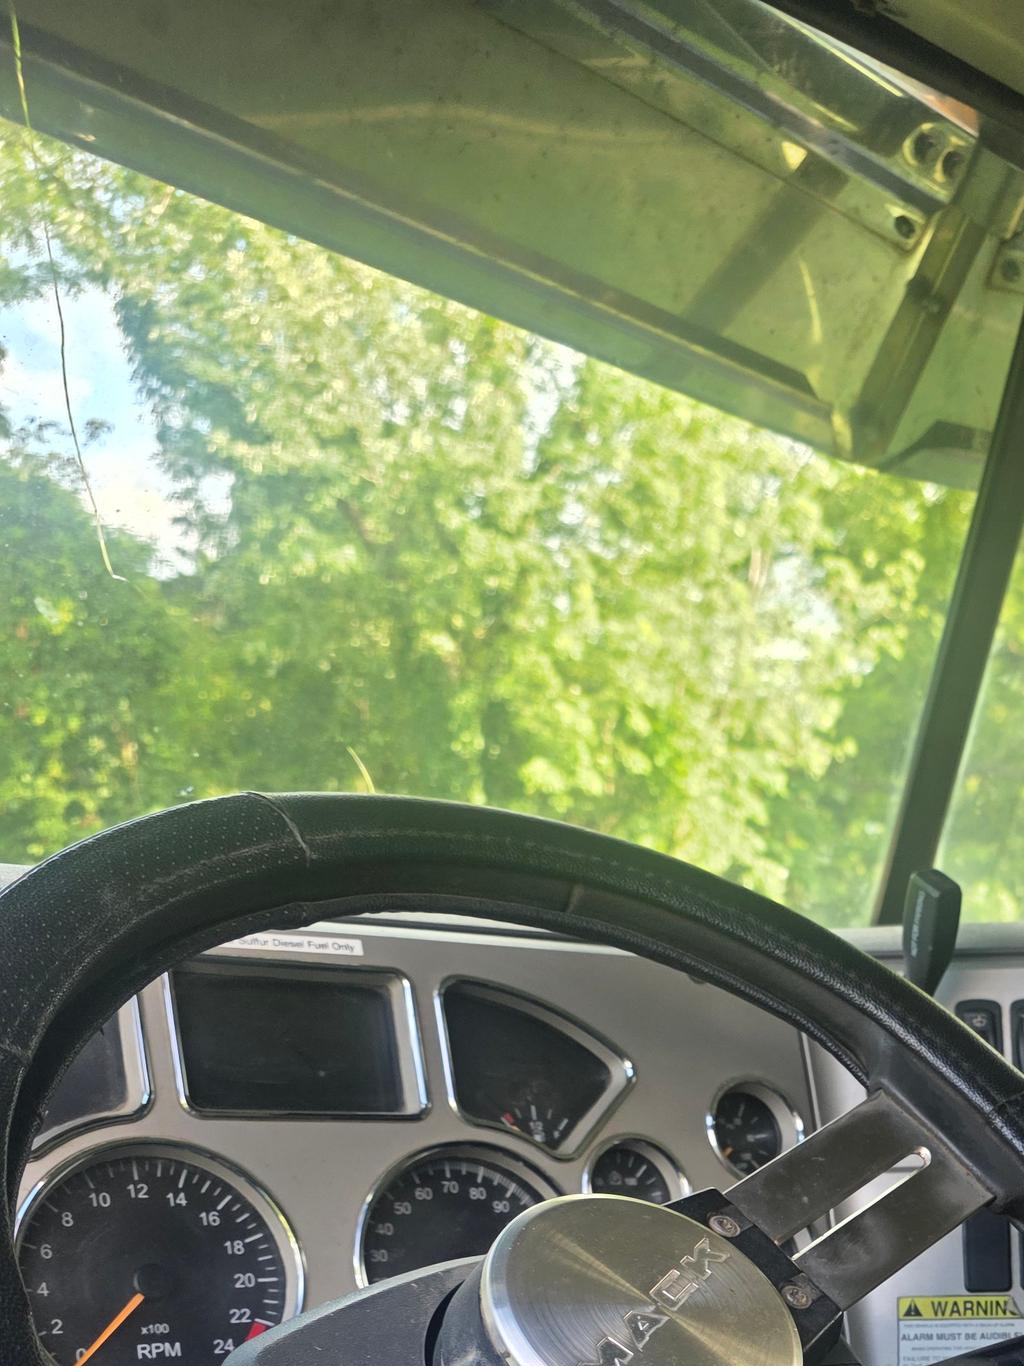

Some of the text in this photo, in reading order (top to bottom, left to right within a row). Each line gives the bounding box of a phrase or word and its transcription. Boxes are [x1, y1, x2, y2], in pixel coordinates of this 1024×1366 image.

[273, 939, 304, 948] Diesel
[308, 941, 329, 950] Fuel
[331, 942, 355, 953] Only
[126, 1183, 149, 1199] 12
[414, 1187, 433, 1200] 60
[441, 1180, 459, 1194] 70
[469, 1186, 487, 1200] 80
[88, 1192, 111, 1207] 10
[166, 1192, 188, 1207] 14
[492, 1200, 510, 1214] 90
[393, 1202, 412, 1215] 50
[61, 1211, 74, 1227] 8
[199, 1211, 221, 1226] 16
[375, 1222, 394, 1236] 40
[40, 1243, 53, 1259] 6
[224, 1240, 245, 1255] 18
[370, 1248, 388, 1262] 30
[233, 1273, 255, 1289] 20
[37, 1282, 49, 1297] 4
[229, 1308, 252, 1324] 22
[51, 1319, 63, 1335] 2
[141, 1323, 170, 1335] x100
[901, 1332, 934, 1342] ALARM
[936, 1332, 962, 1341] MUST
[965, 1332, 977, 1341] BE
[136, 1342, 182, 1360] RPM
[213, 1338, 235, 1354] 24
